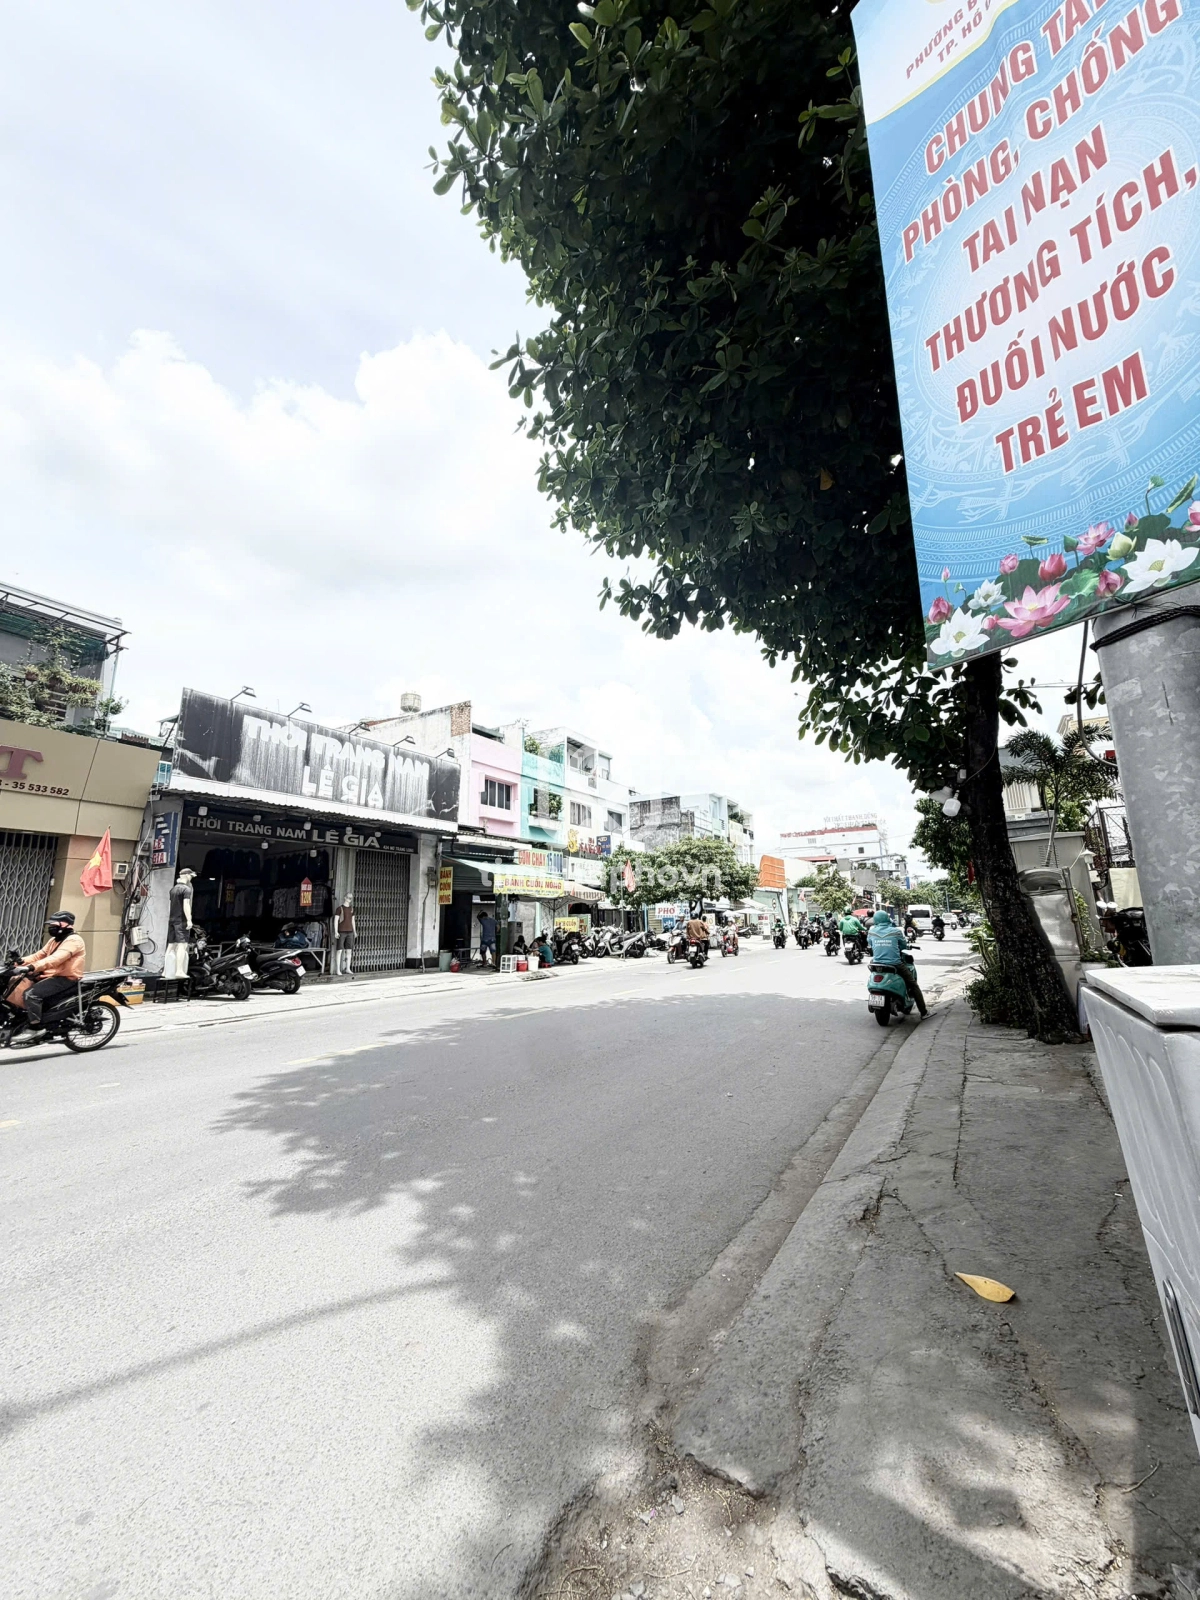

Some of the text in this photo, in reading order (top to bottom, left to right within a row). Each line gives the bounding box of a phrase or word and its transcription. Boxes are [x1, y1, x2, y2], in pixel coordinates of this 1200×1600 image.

[906, 9, 964, 79] PHƯỜNG
[926, 0, 1107, 173] CHUNG TA
[937, 39, 958, 63] TP.
[902, 0, 1179, 262] PHÒNG, CHỐNG
[963, 124, 1107, 272] TAI NẠN
[925, 149, 1197, 371] THƯƠNG TÍCH,
[956, 247, 1174, 424] ĐUỐI NƯỚC
[995, 352, 1147, 473] TRẺ EM
[12, 781, 26, 790] 35
[28, 783, 48, 793] 533
[50, 786, 70, 796] 582
[187, 815, 381, 849] THỜI TRANG NAM LÊ GIA
[302, 763, 384, 809] LÊ GIA
